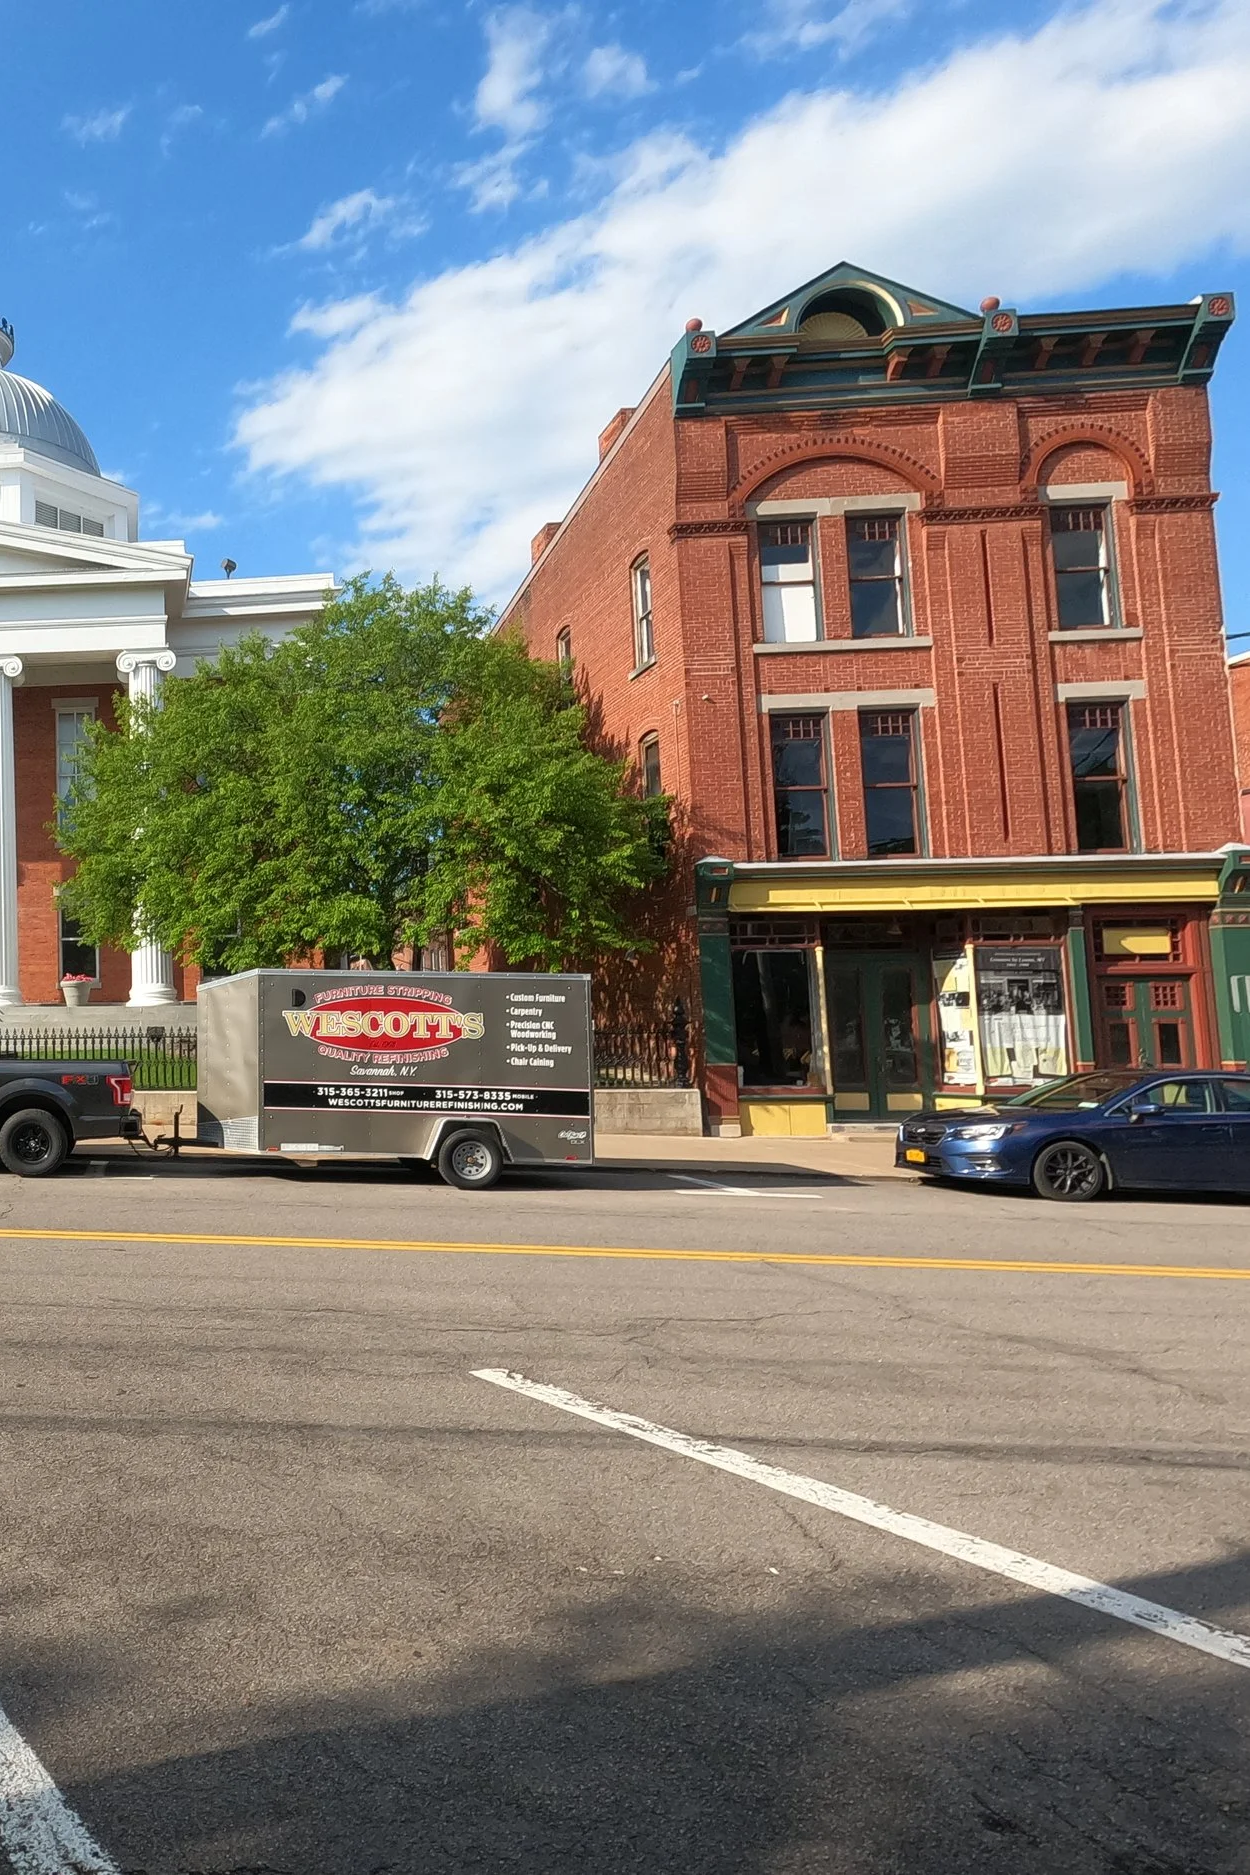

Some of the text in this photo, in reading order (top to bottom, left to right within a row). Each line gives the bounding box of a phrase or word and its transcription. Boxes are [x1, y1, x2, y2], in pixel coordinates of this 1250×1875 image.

[314, 985, 453, 1005] FURNITURE STRIPPING
[510, 993, 566, 1003] Custom Furniture
[510, 1007, 543, 1017] Carpentry
[282, 1010, 485, 1040] WESCOTT'S
[510, 1020, 554, 1030] Precision CNC
[510, 1029, 557, 1040] Woodworking
[510, 1043, 572, 1054] Pick-Up & Delivery
[318, 1045, 450, 1064] QUALITY REFINISHING
[510, 1057, 529, 1066] Chair
[350, 1065, 418, 1077] Savannah, N.Y.
[317, 1087, 388, 1098] 315-365-3211
[435, 1089, 511, 1101] 315-573-8335
[328, 1098, 523, 1111] WESCOTTSFURNITUREREFINISHING.COM
